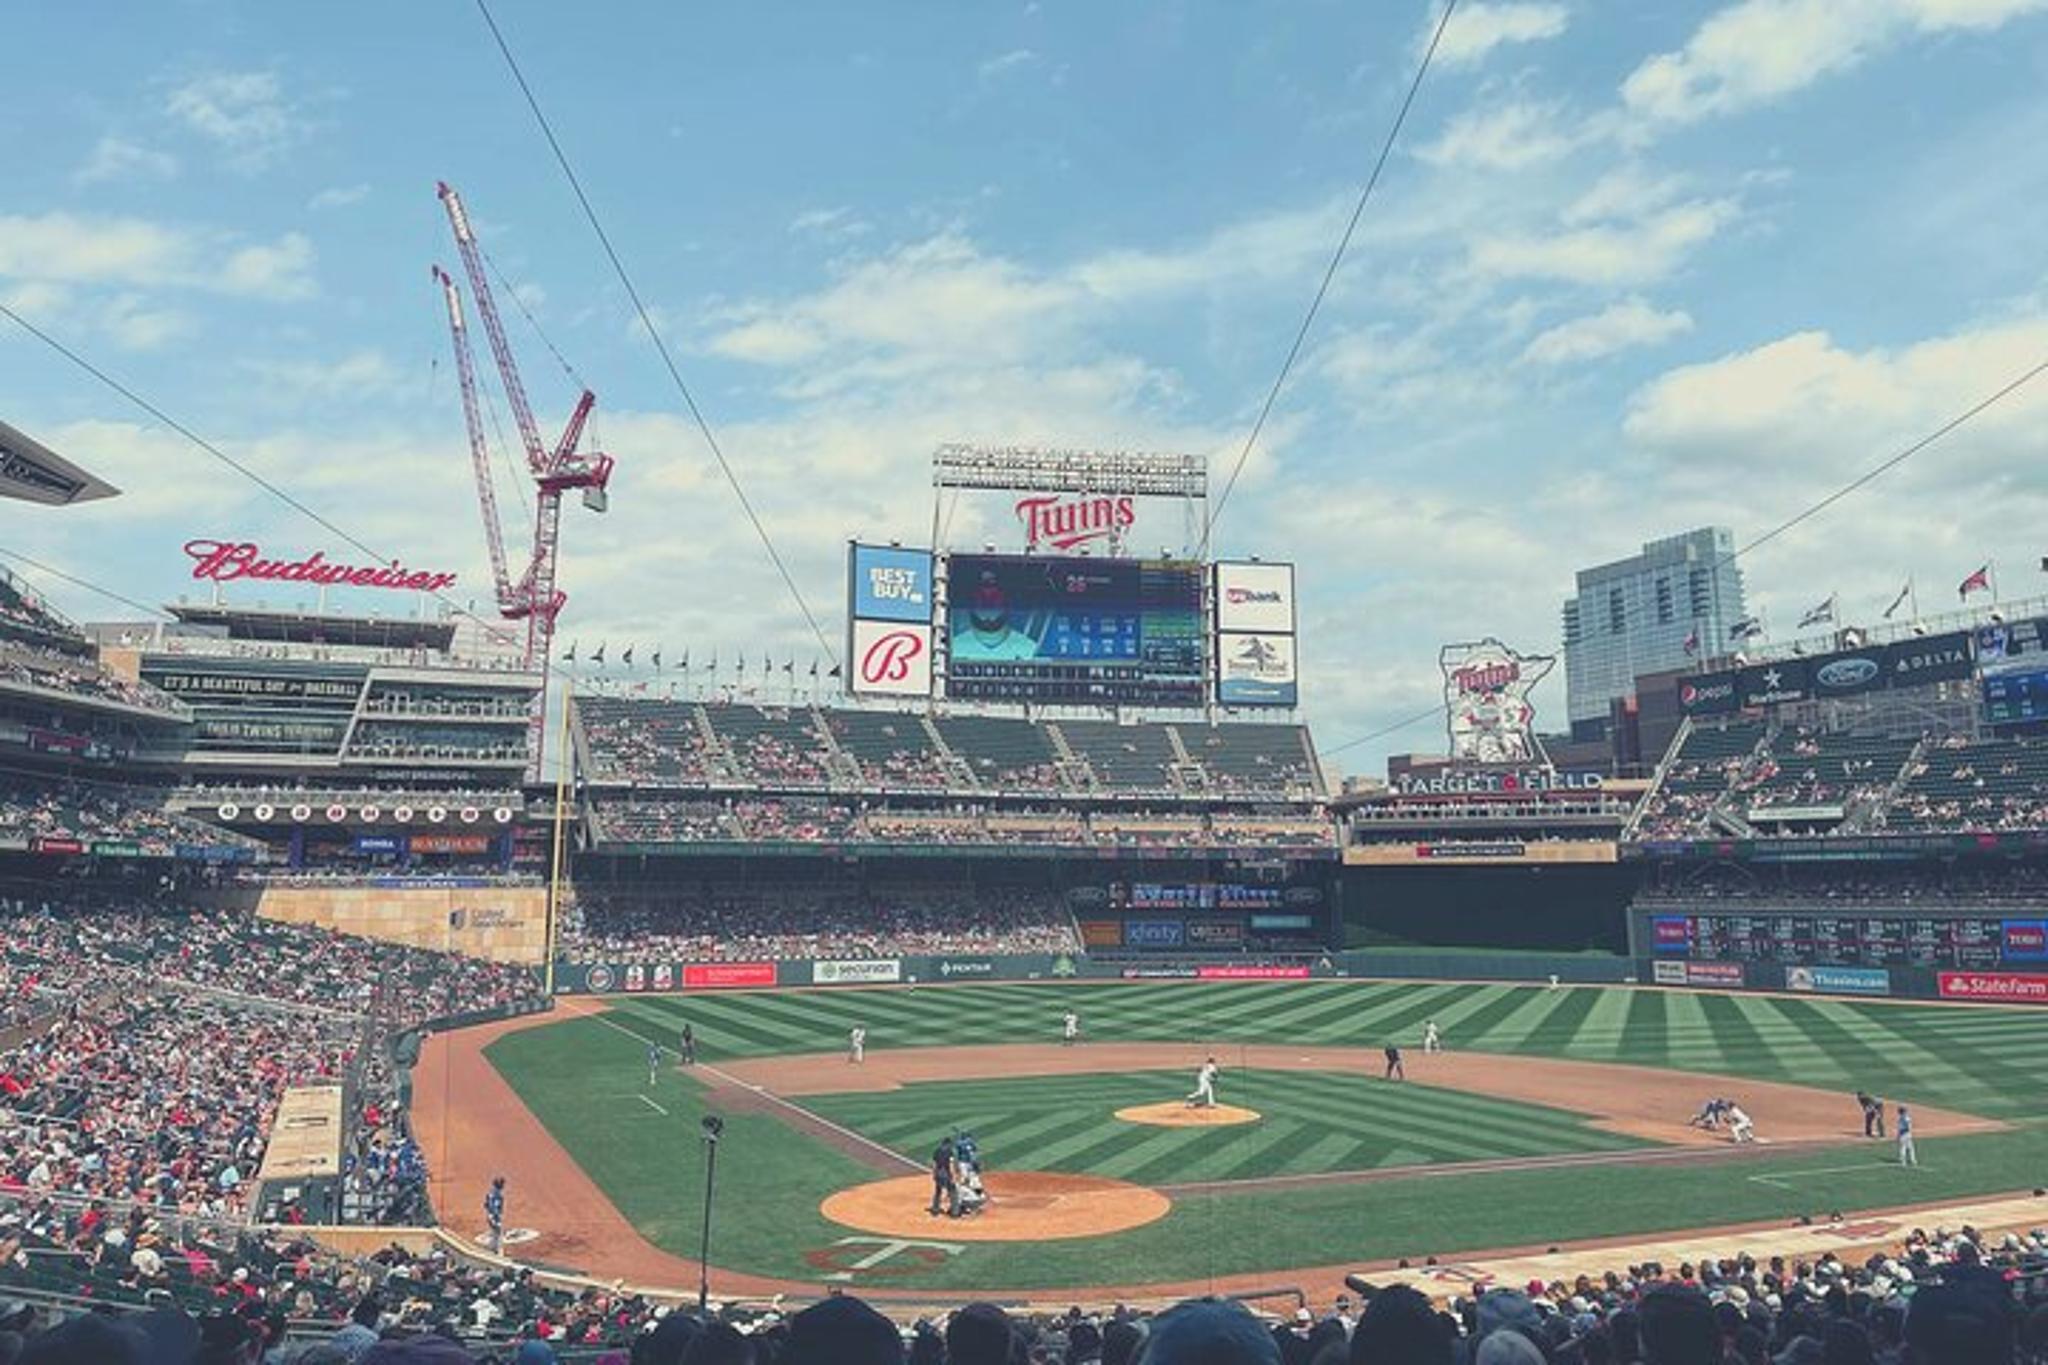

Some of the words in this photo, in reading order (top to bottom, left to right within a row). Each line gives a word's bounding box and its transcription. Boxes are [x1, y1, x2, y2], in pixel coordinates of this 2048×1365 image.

[1015, 495, 1135, 545] Twins
[184, 540, 457, 591] Budweiser
[869, 567, 917, 585] BEST
[873, 582, 913, 599] BUY
[862, 631, 922, 683] B
[1911, 650, 1965, 669] DELTA
[164, 675, 189, 691] IT'S
[190, 677, 200, 690] A
[201, 676, 263, 693] BEAUTIFUL
[264, 681, 286, 693] DAY
[305, 681, 357, 697] BASEBALL
[1451, 661, 1521, 694] Twins
[1698, 684, 1733, 700] pepsi
[243, 723, 282, 739] TWINS
[1399, 774, 1499, 794] TARGET
[1525, 771, 1603, 791] FIELD
[838, 961, 895, 974] securian
[1970, 977, 2012, 993] State
[2012, 979, 2046, 995] Farm
